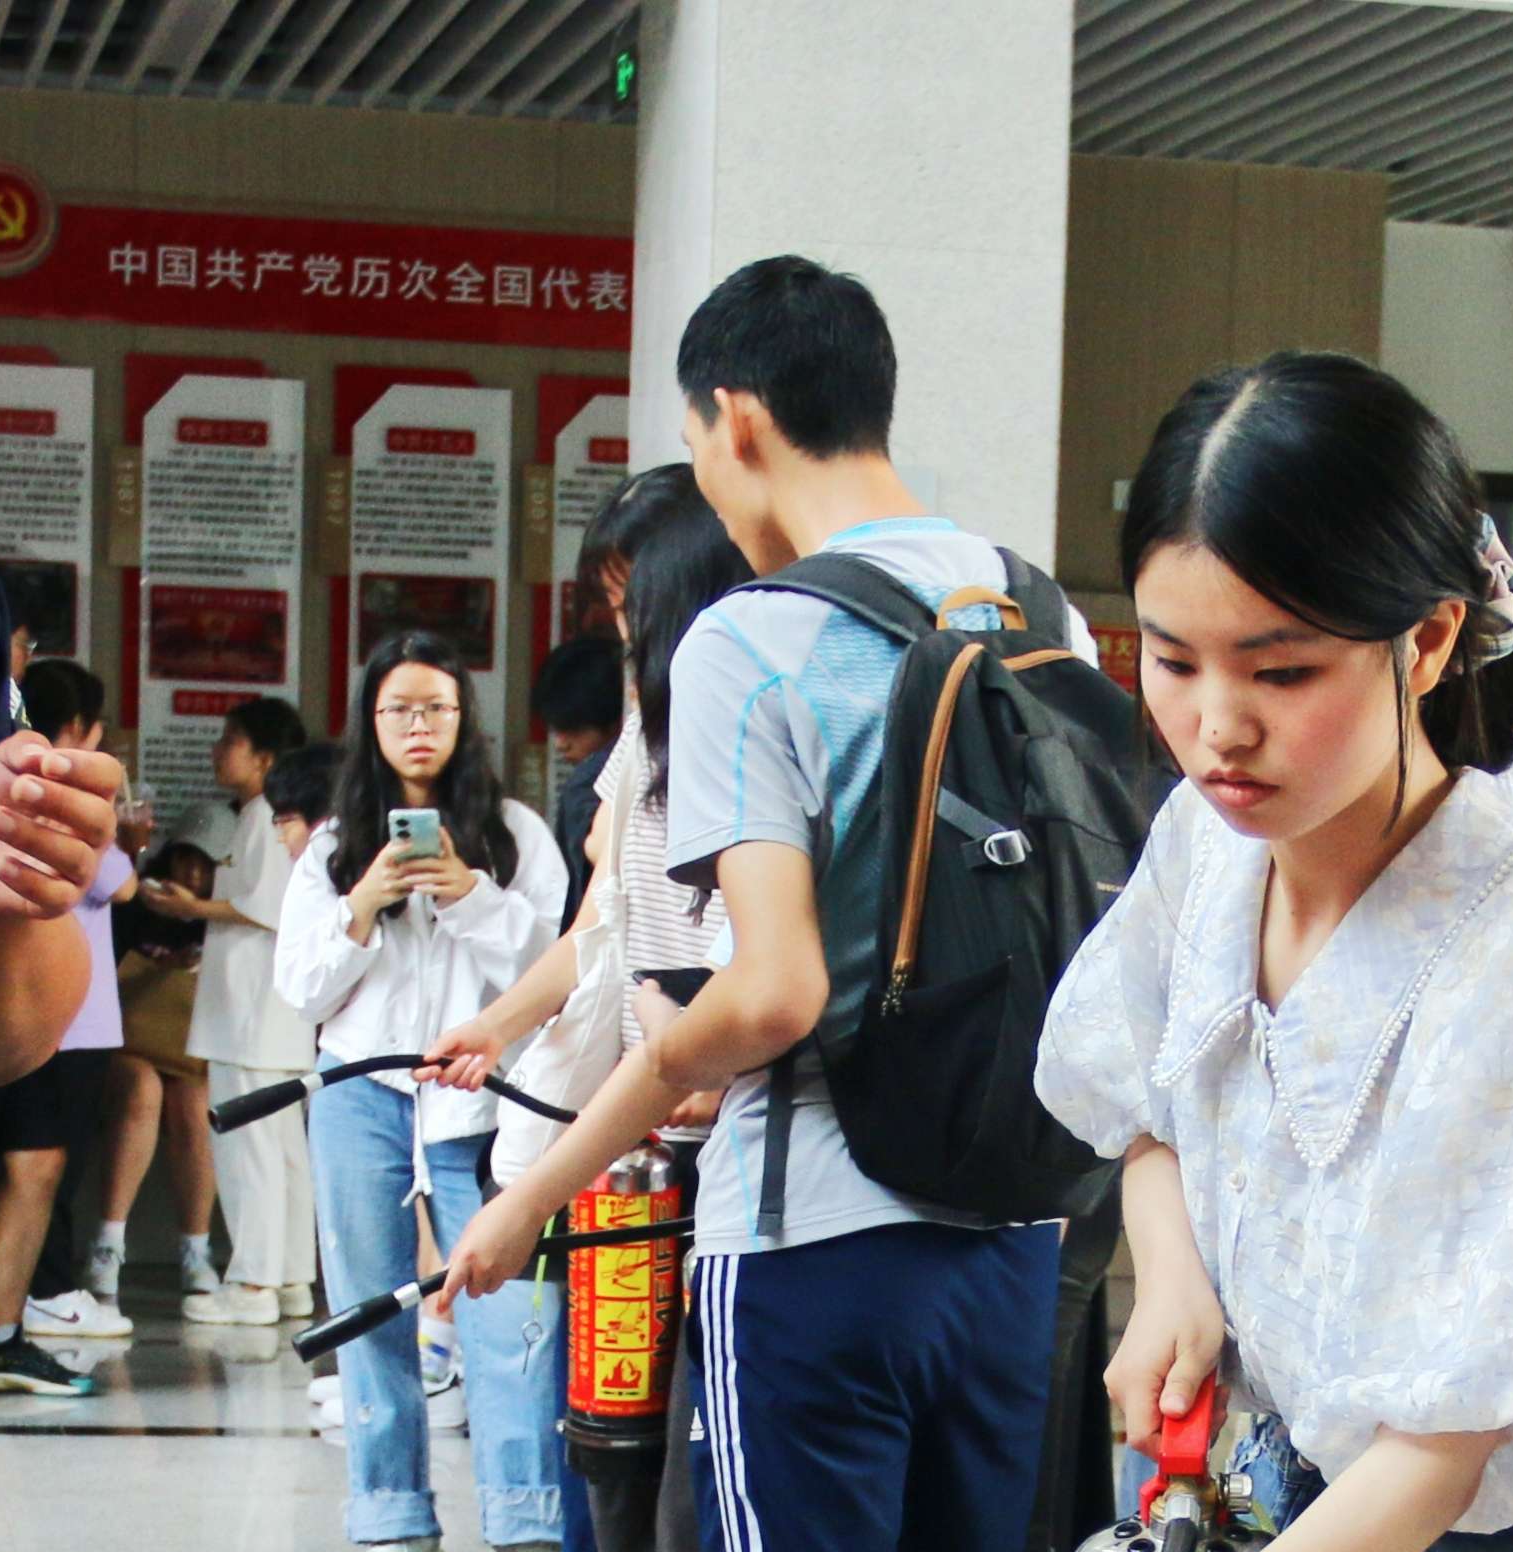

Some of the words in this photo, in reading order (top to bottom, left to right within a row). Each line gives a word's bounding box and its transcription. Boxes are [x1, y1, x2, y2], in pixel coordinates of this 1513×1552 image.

[108, 242, 628, 312] 中国共产党历次全国代表
